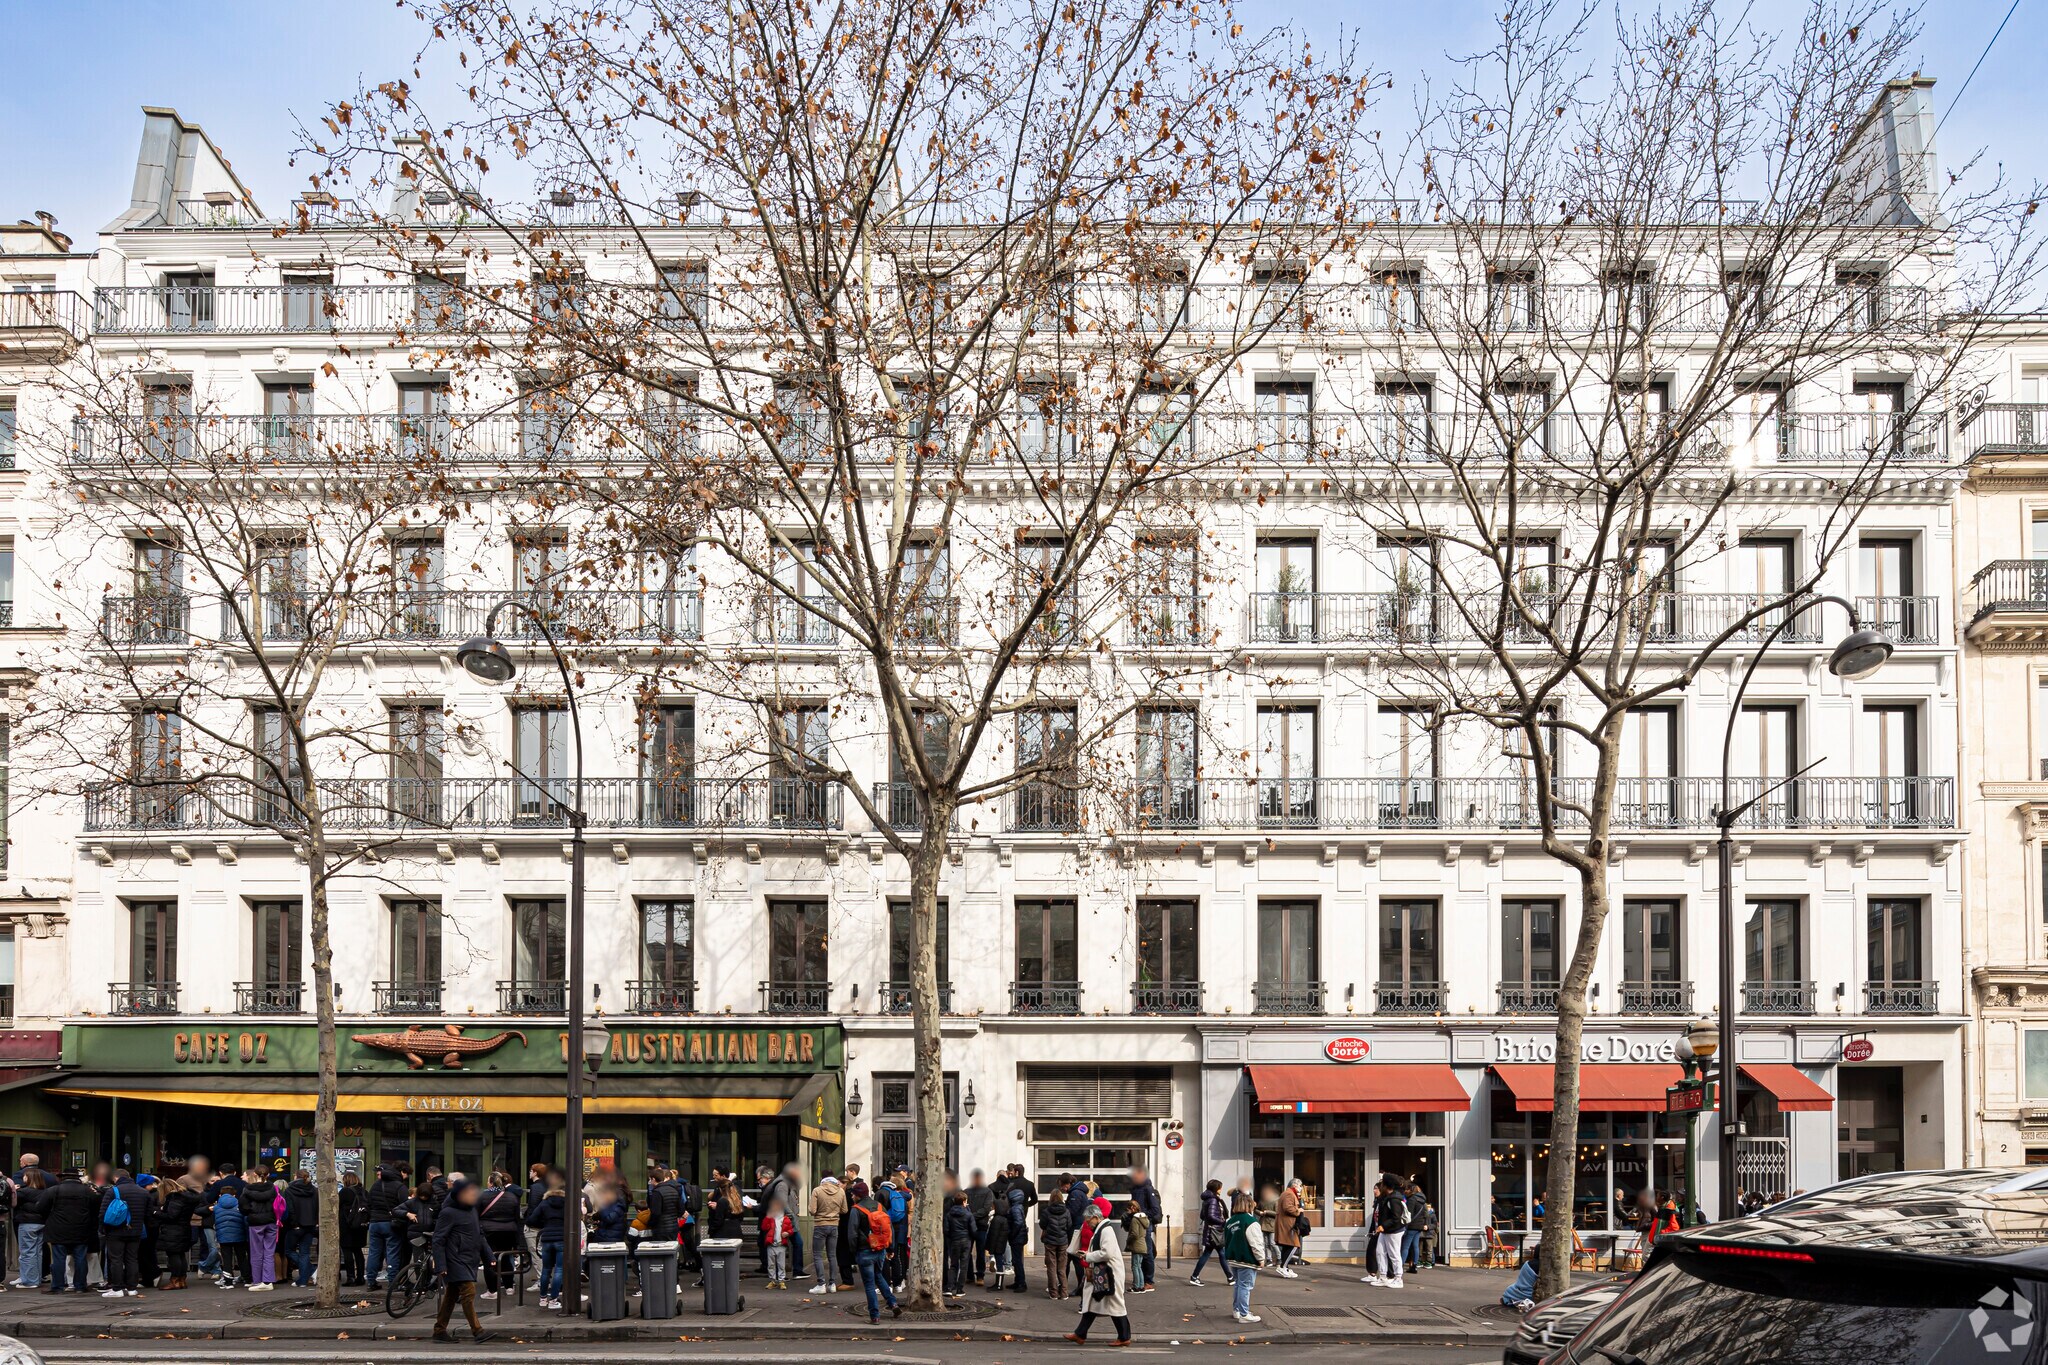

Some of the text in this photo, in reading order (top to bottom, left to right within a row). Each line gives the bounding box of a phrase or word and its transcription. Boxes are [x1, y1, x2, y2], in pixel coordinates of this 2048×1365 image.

[174, 1032, 268, 1063] CAFE OZ
[610, 1033, 757, 1063] AUSTRALIAN
[767, 1033, 814, 1063] BAR
[1332, 1047, 1366, 1056] Dorée
[1495, 1036, 1681, 1062] Brioe Doré
[1847, 1050, 1870, 1059] Dorée
[406, 1097, 482, 1110] CAFE OZ
[2000, 1143, 2008, 1153] 2
